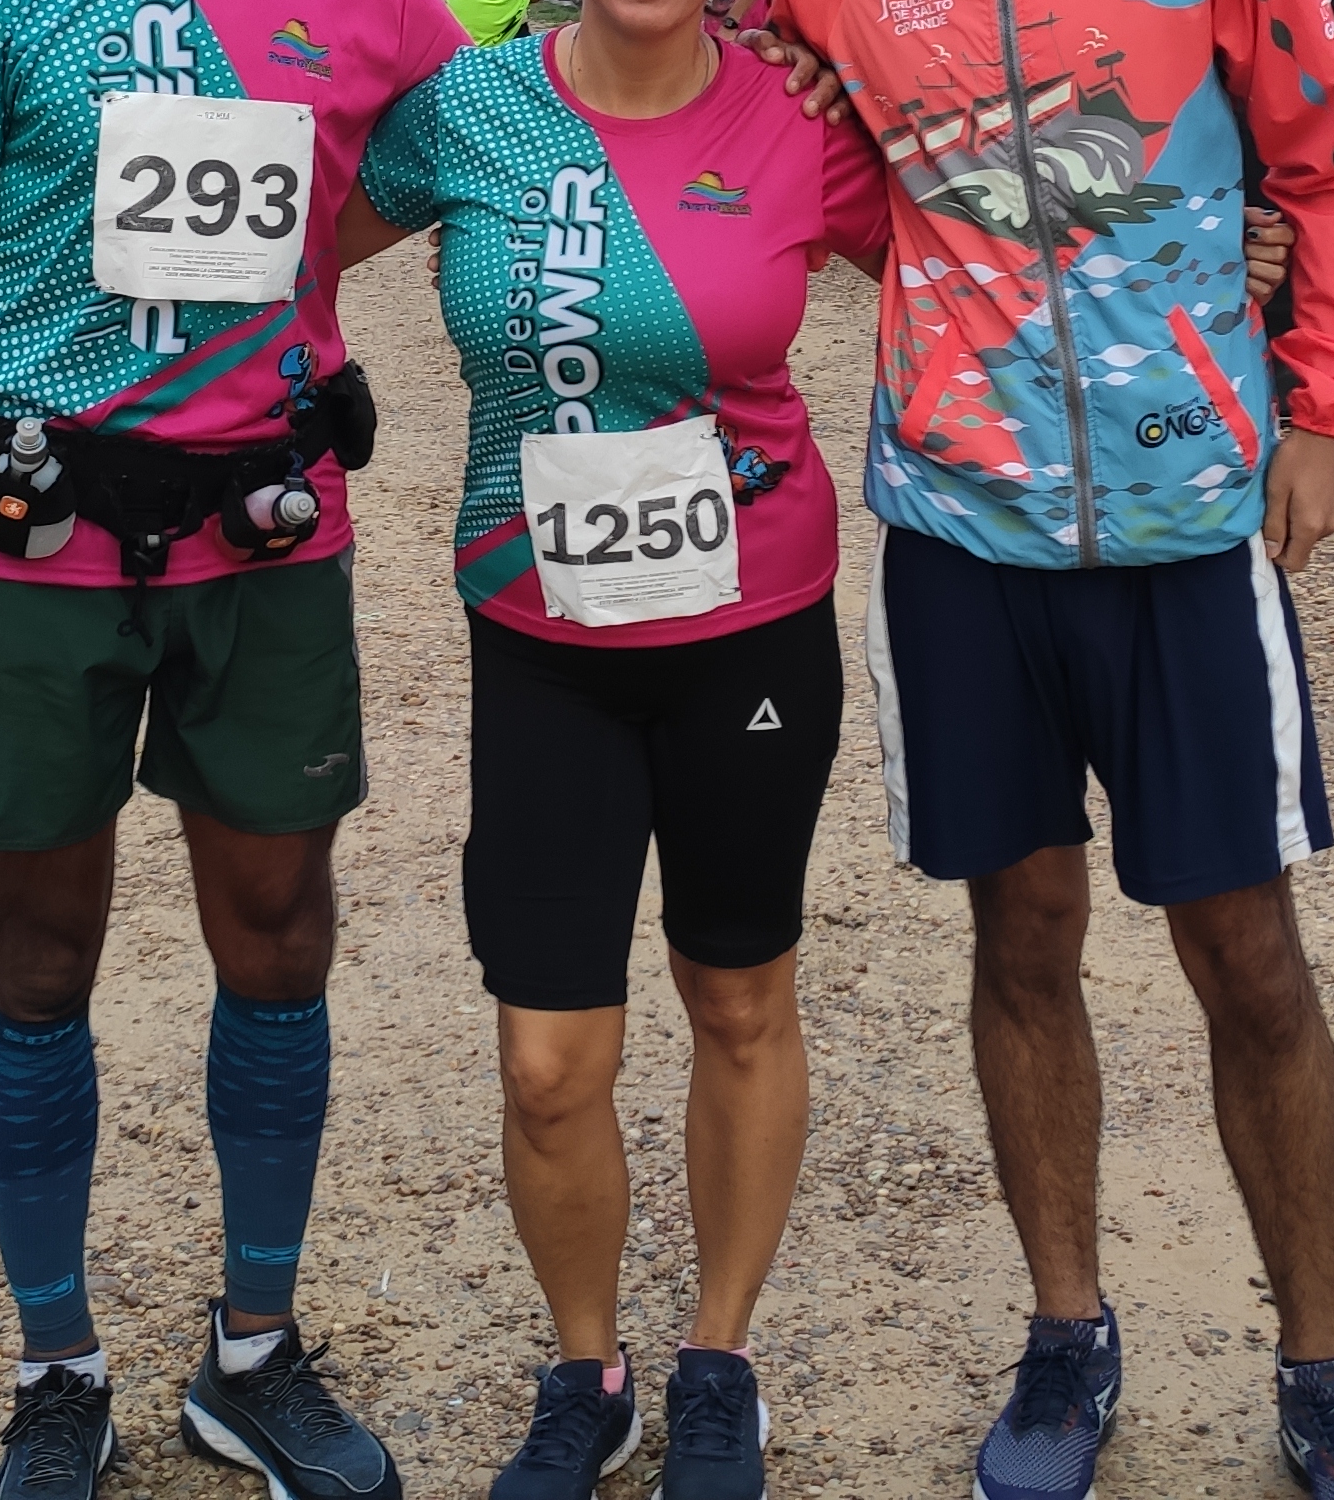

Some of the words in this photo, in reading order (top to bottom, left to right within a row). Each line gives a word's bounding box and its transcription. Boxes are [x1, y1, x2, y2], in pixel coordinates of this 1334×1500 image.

[892, 9, 910, 23] DE
[894, 12, 949, 36] GRANDE
[116, 154, 299, 240] 293
[536, 487, 730, 566] 1250
